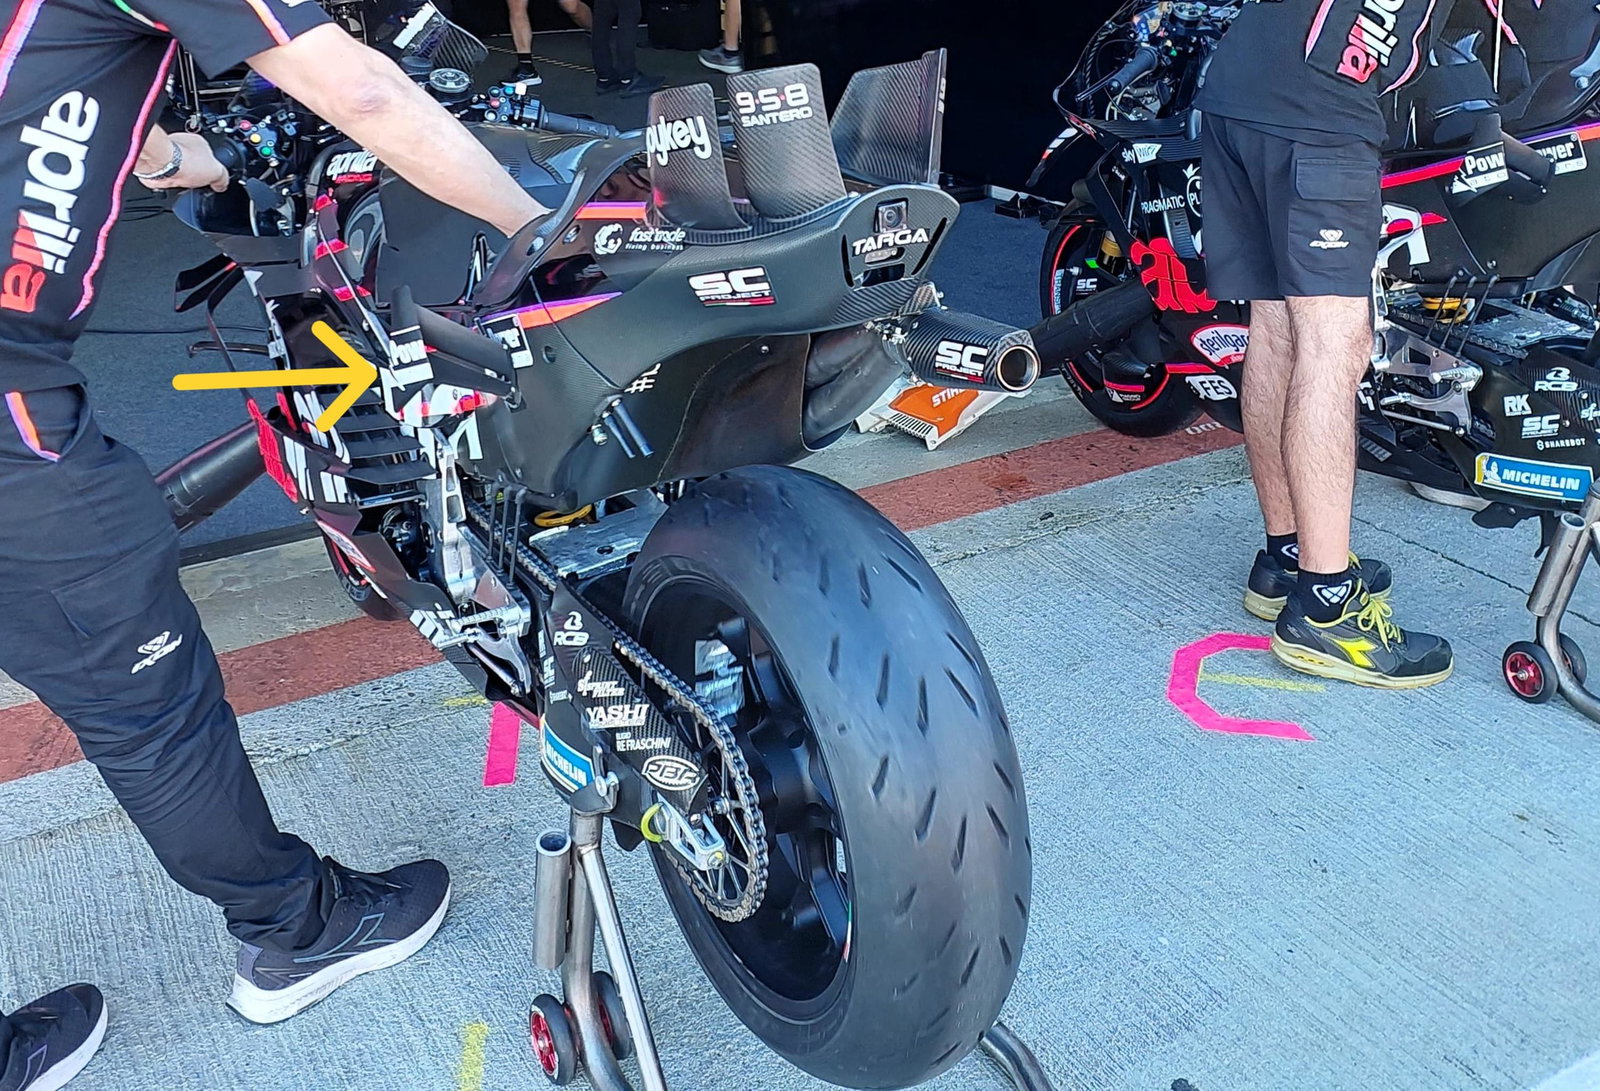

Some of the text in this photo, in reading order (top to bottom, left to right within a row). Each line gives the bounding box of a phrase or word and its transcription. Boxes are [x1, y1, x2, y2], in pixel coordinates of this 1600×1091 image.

[741, 107, 813, 128] SANTERO
[0, 90, 100, 313] aprilia
[1141, 195, 1185, 214] PRAGMATIC
[851, 228, 930, 257] TARGA
[689, 267, 771, 297] SC
[1077, 278, 1097, 289] SC
[699, 290, 772, 302] PROJECT
[936, 340, 989, 371] SC
[935, 362, 984, 378] PROJECT
[1535, 381, 1578, 392] RCB
[1504, 394, 1531, 412] RK
[1522, 414, 1560, 432] SC
[1502, 468, 1580, 490] MICHELIN
[554, 631, 589, 646] RCB
[586, 704, 650, 721] YASHI
[627, 737, 671, 751] FRASCHINI
[546, 739, 588, 786] MICHELIN
